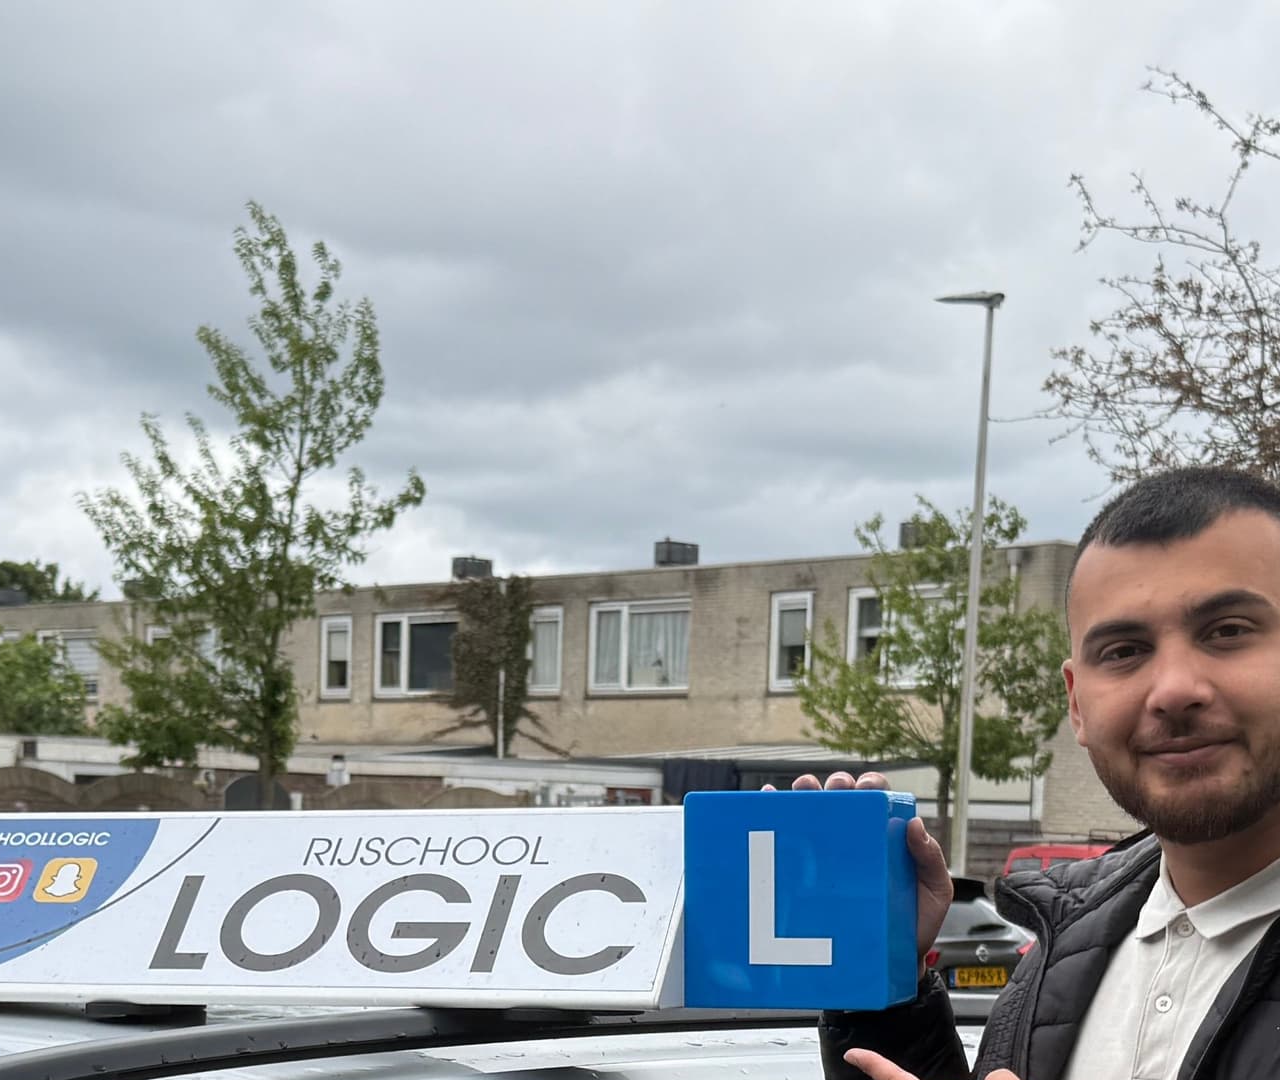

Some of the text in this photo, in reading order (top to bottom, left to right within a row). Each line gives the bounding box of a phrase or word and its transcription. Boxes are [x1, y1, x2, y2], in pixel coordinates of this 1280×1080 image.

[302, 835, 550, 866] RIJSCHOOL
[748, 830, 833, 966] L
[148, 872, 648, 975] LOGIC
